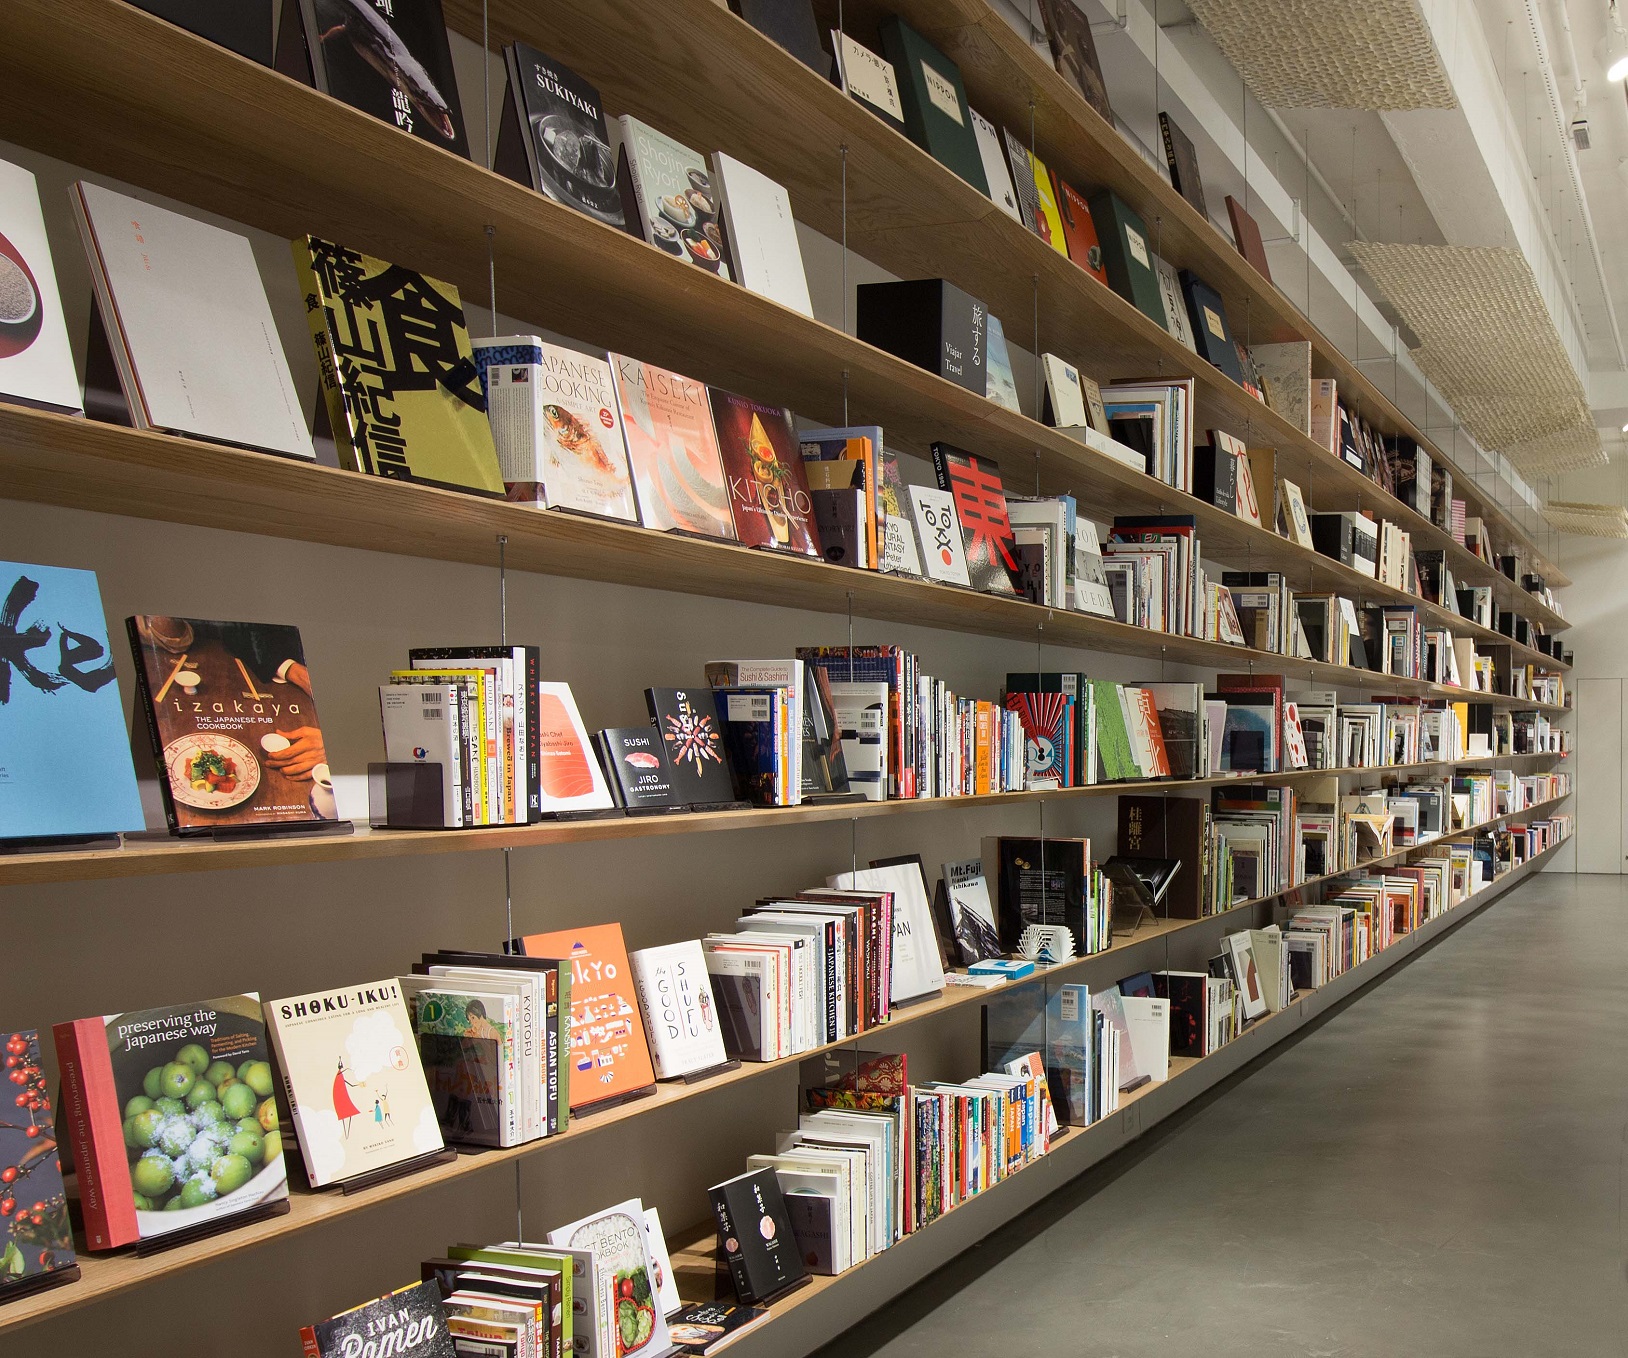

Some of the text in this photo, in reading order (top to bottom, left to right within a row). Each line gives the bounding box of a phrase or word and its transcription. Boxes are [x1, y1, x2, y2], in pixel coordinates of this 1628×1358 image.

[536, 73, 598, 120] SUKIYAKI
[926, 74, 957, 104] NIPPON
[639, 136, 687, 174] Shojin
[630, 159, 639, 183] Shojin
[643, 158, 681, 192] Ryori
[305, 292, 319, 314] 食
[338, 263, 488, 415] 食
[972, 304, 983, 366] 旅する
[314, 330, 337, 390] 篠山紀信
[945, 342, 963, 360] Viajar
[541, 352, 607, 388] APANESE
[945, 358, 963, 377] Travel
[543, 373, 613, 409] OOKING
[617, 360, 702, 407] KAISEKI
[727, 396, 782, 418] KUNIO TOKUOKA
[933, 447, 946, 488] TOKYO 1981
[729, 475, 812, 516] KITCHO
[1081, 590, 1113, 610] UEDA
[0, 575, 118, 705] ke
[740, 672, 788, 682] Sushi & Sashimi
[174, 698, 300, 716] izakaya
[677, 691, 695, 739] Sushi
[563, 740, 574, 748] Jiro
[624, 738, 650, 747] SUSHI
[507, 764, 512, 773] in
[639, 775, 659, 784] JIRO
[629, 784, 670, 793] GASTRONOMY
[1129, 807, 1142, 851] 桂離宮
[950, 862, 981, 878] Mt.Fuji
[893, 922, 912, 938] PAN
[429, 1003, 436, 1015] 1
[658, 979, 679, 1040] GOOD
[677, 961, 699, 1038] SHUFU
[118, 1009, 217, 1039] preserving the
[125, 1022, 217, 1051] japanese way
[523, 995, 532, 1057] KYOTOFU
[564, 1015, 572, 1057] KANSHA
[210, 1035, 231, 1044] Traditions
[549, 1031, 557, 1067] ASIAN
[66, 1061, 98, 1211] preserving the japanese way
[753, 1183, 766, 1214] 和菓子
[717, 1202, 731, 1233] 和菓子
[600, 1226, 635, 1249] BENTO
[341, 1315, 438, 1358] Ramen
[367, 1308, 410, 1336] IVAN
[304, 1338, 314, 1346] IVAN
